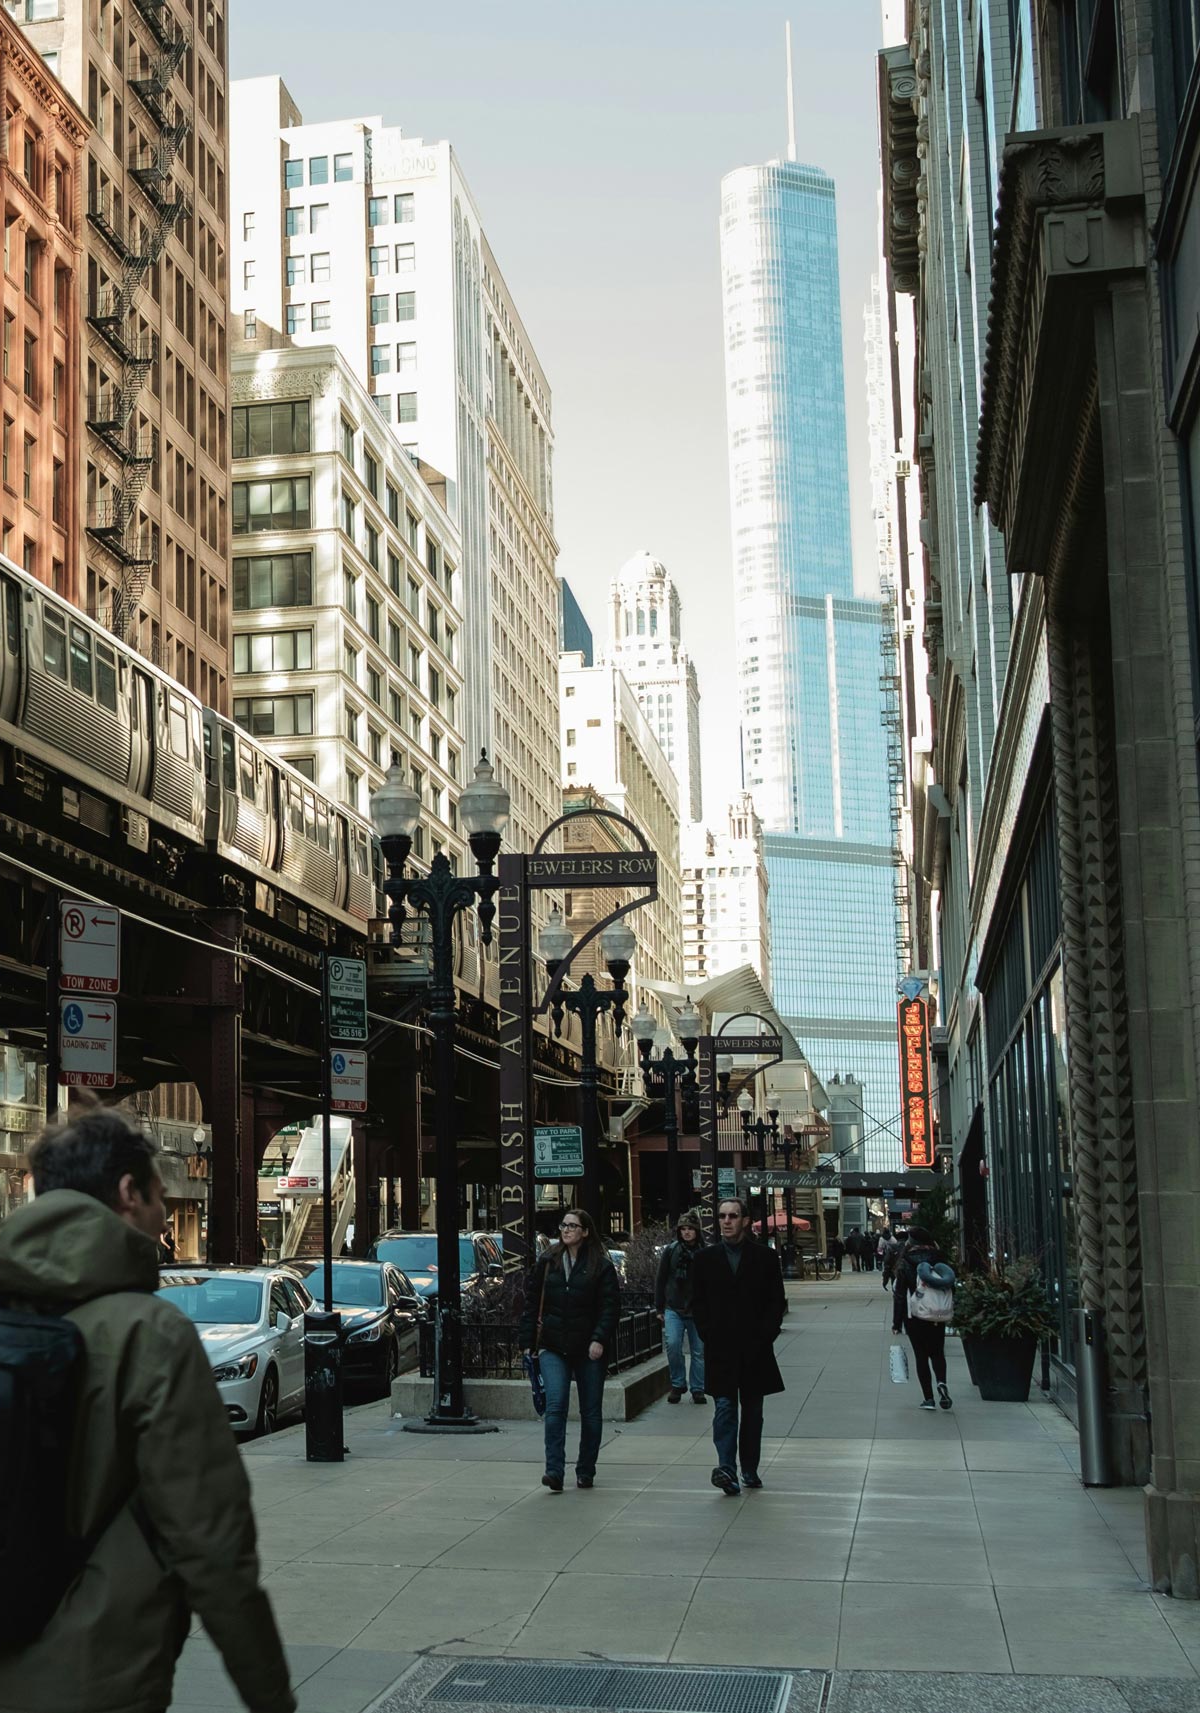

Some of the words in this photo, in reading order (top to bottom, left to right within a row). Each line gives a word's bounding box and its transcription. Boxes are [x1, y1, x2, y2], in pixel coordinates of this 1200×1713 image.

[526, 860, 613, 875] JEWELERS
[618, 859, 657, 874] ROW
[497, 884, 522, 1057] AVENUE
[66, 976, 85, 989] TOW
[89, 977, 112, 991] ZONE
[62, 1039, 89, 1049] LOADING
[91, 1040, 107, 1050] ZONE
[714, 1039, 760, 1049] JEWELERS
[761, 1039, 782, 1048] ROW
[903, 1003, 924, 1093] JEWELERS
[65, 1072, 83, 1084] TOW
[86, 1073, 109, 1086] ZONE
[699, 1051, 712, 1142] AVENUE
[334, 1101, 346, 1109] TOW
[348, 1101, 363, 1110] ZONE
[500, 1102, 525, 1274] WABASH
